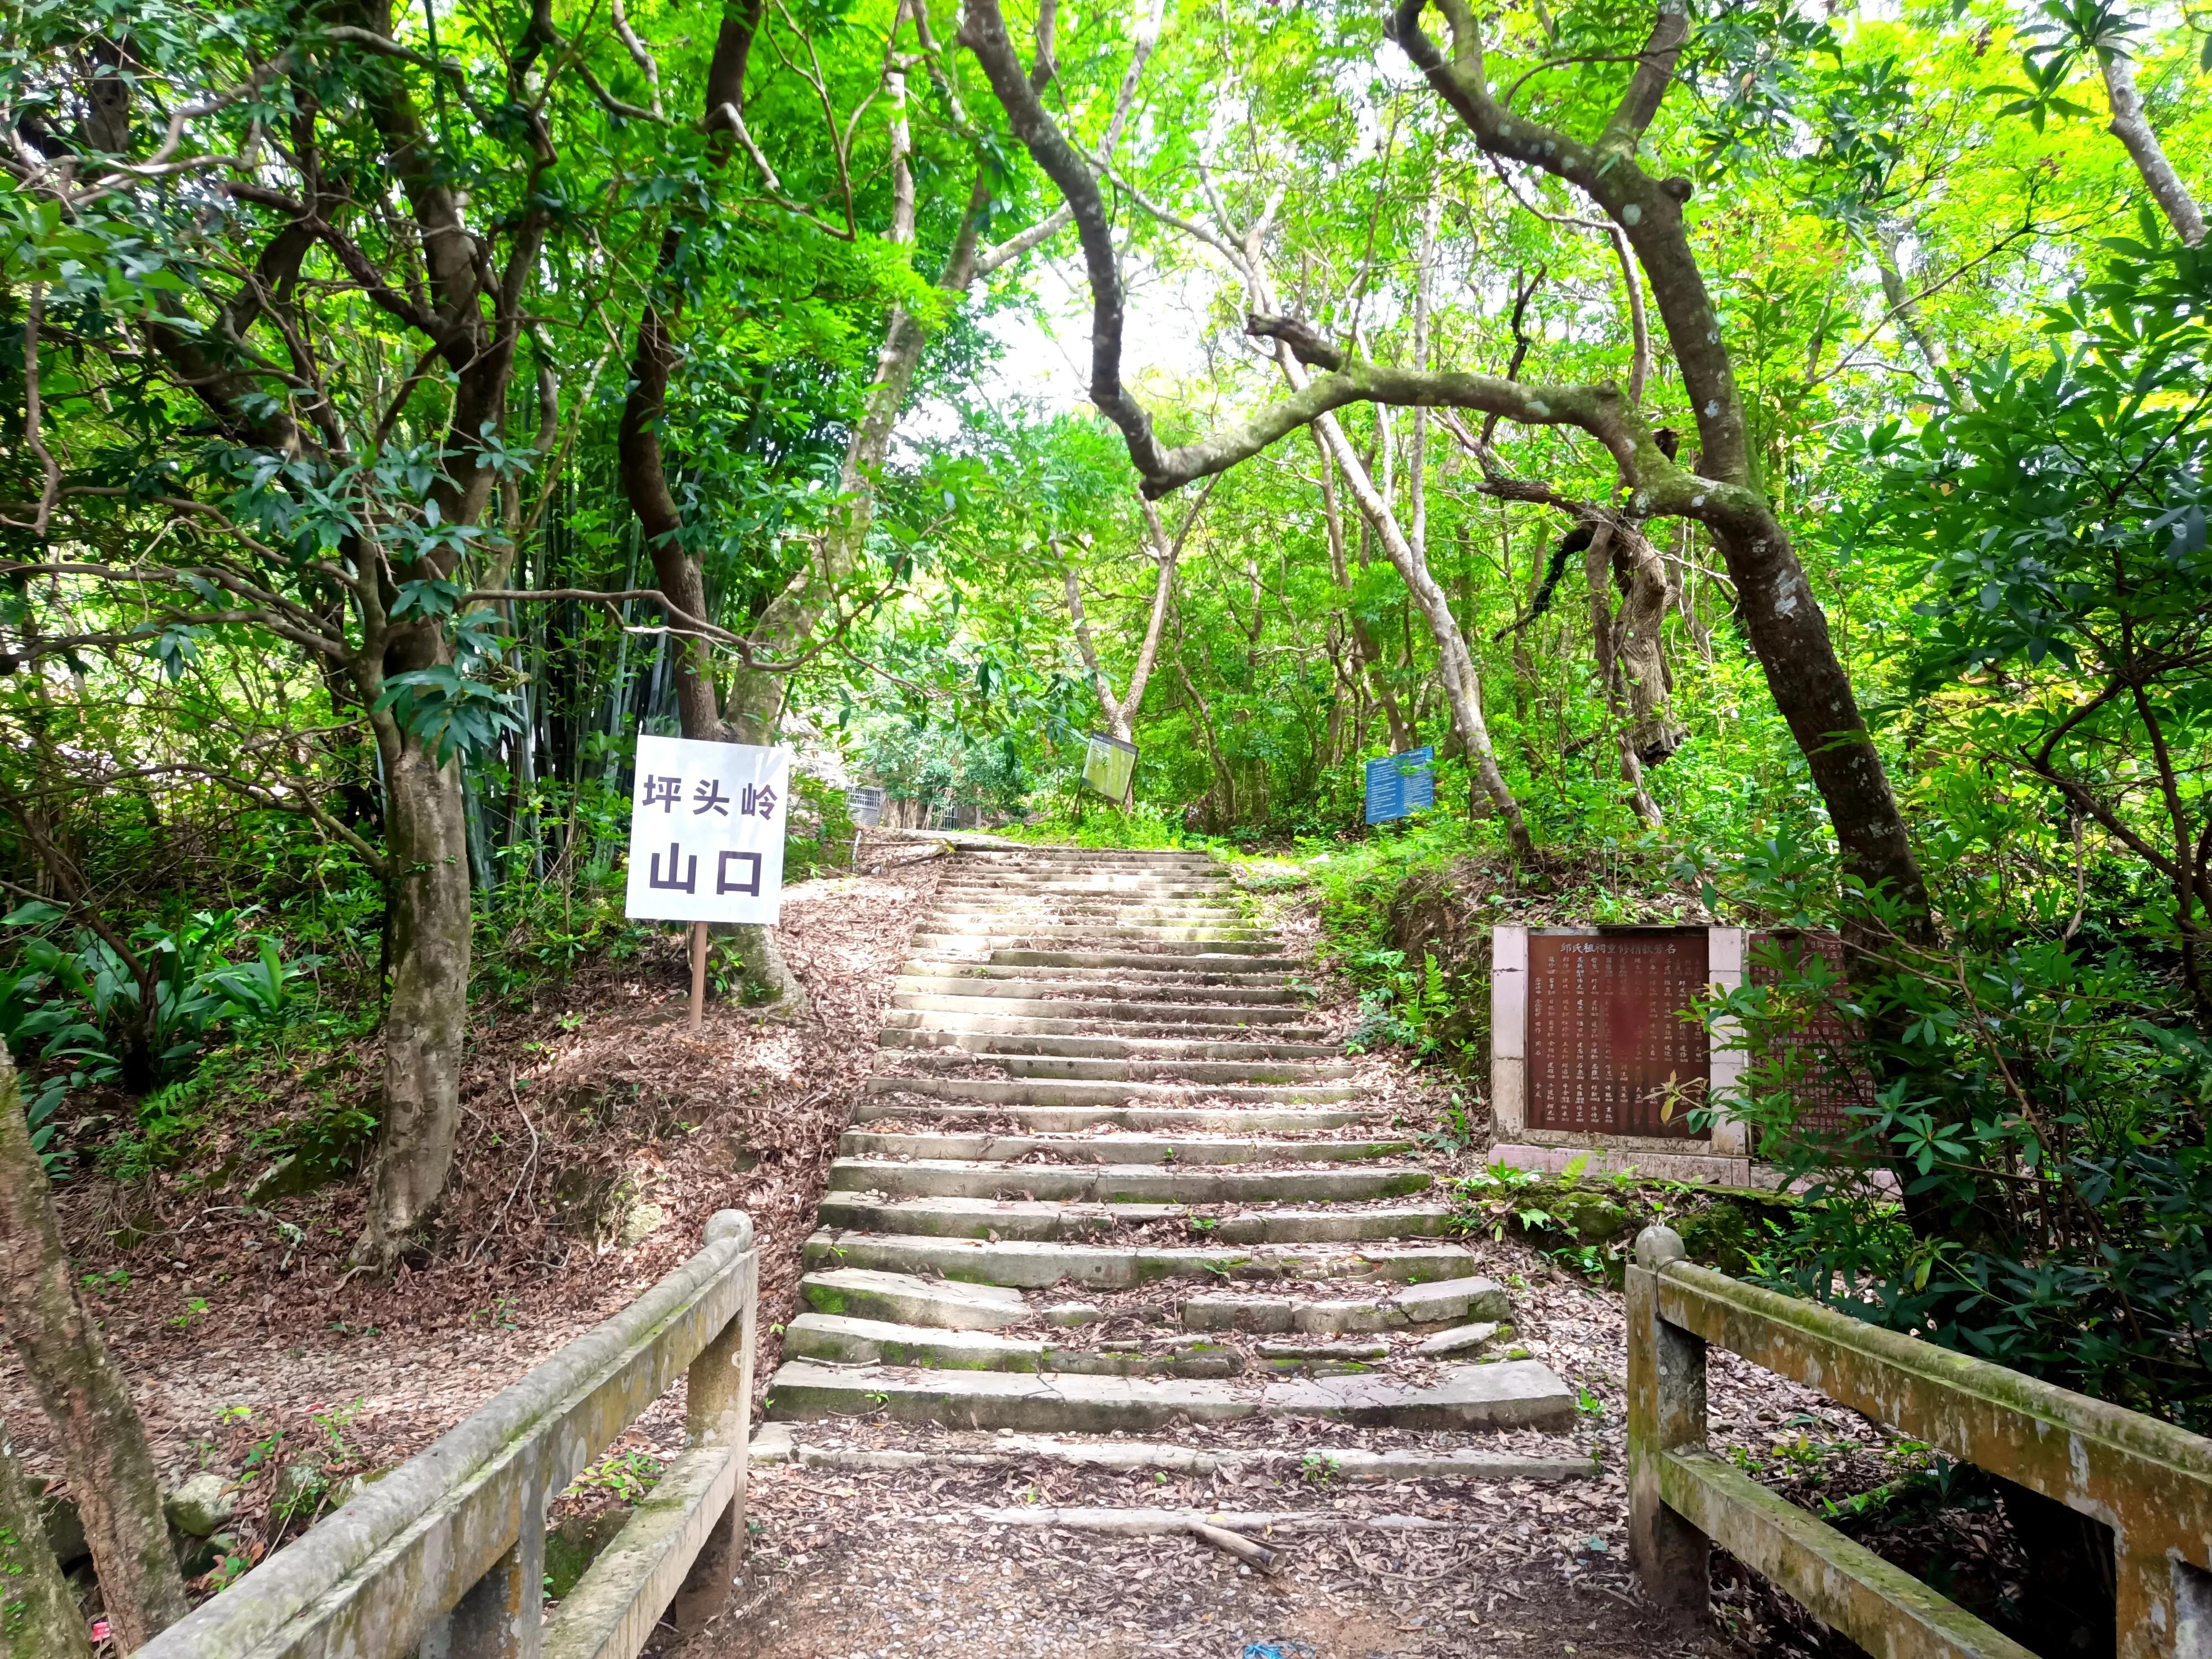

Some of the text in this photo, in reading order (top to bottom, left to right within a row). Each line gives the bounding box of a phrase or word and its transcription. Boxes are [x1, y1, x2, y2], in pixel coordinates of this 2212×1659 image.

[642, 774, 778, 820] 坪头岭
[650, 843, 761, 896] 山口
